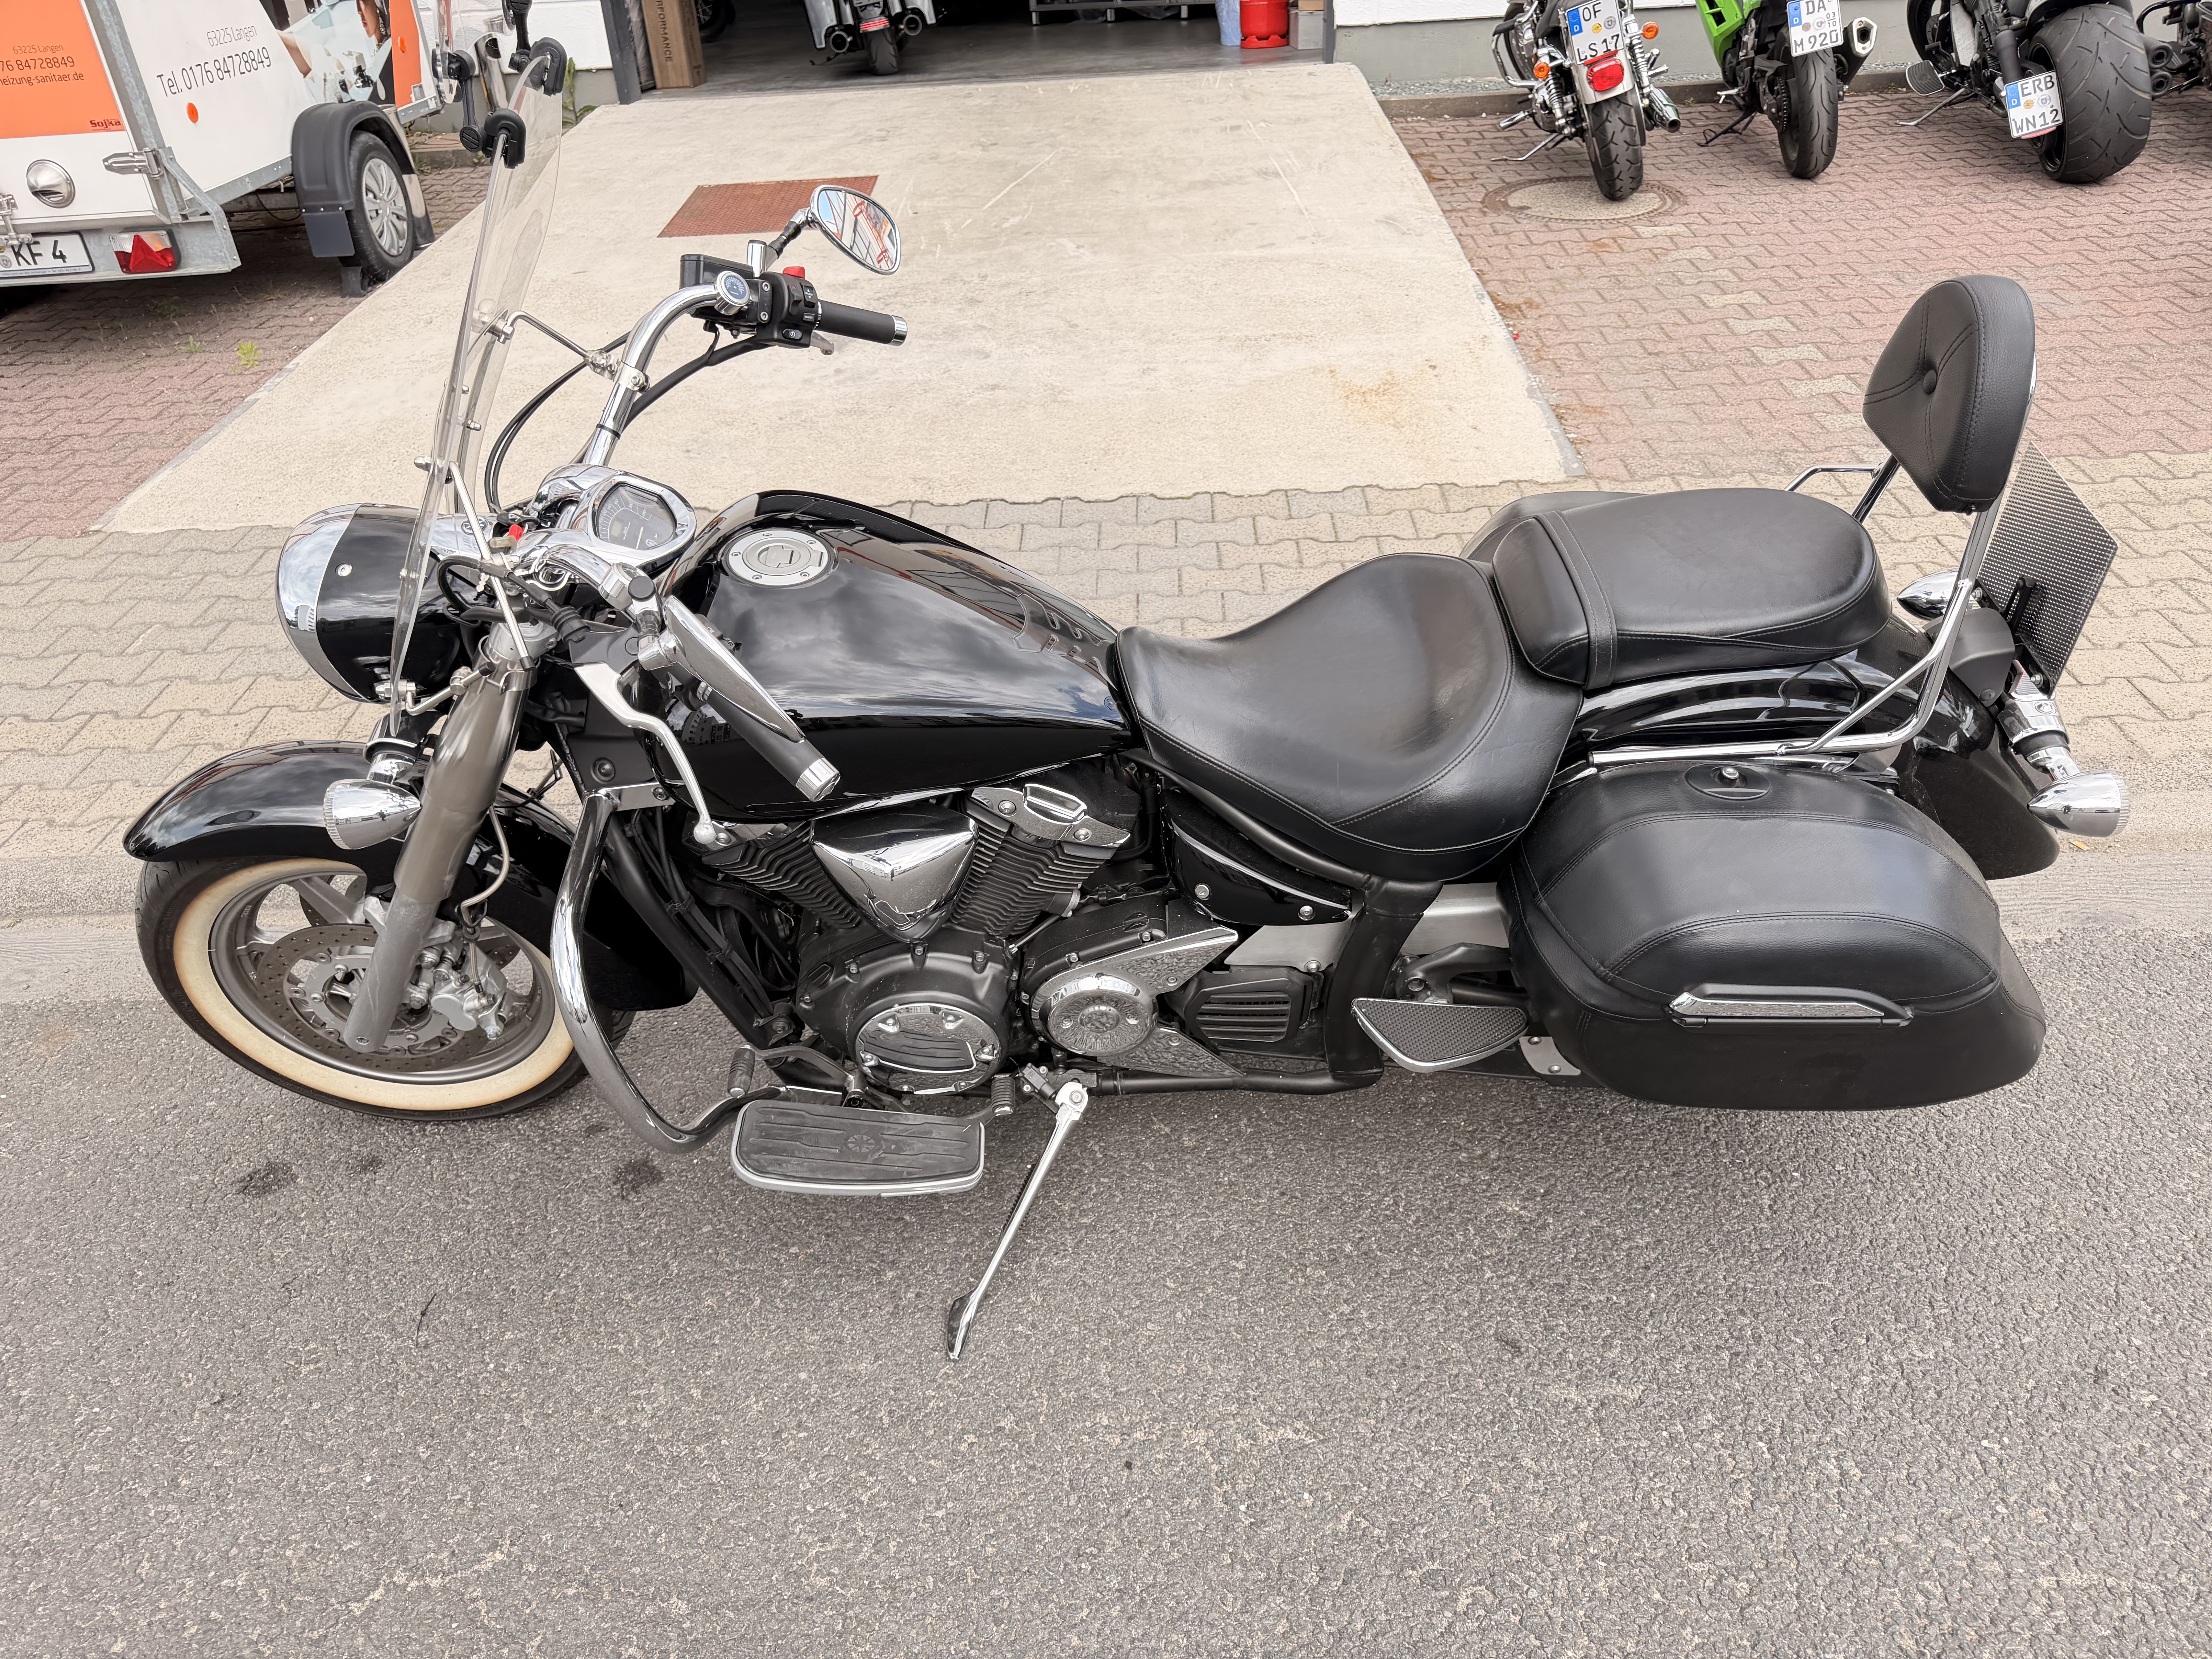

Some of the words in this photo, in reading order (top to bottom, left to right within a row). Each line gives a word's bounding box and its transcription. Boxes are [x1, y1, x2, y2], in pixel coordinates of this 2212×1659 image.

[1582, 2, 1601, 22] OF
[1805, 0, 1826, 15] DA
[206, 27, 232, 47] 63225
[230, 26, 257, 41] Langen
[1794, 38, 1804, 53] M
[1808, 29, 1839, 49] 920
[12, 45, 37, 54] 63225
[38, 45, 64, 53] Langen
[1577, 43, 1598, 62] LS
[1602, 34, 1620, 53] 17
[15, 56, 75, 70] 84728849
[156, 71, 183, 97] Tel.
[181, 62, 214, 90] 0176
[213, 47, 271, 81] 84728849
[2020, 75, 2055, 98] ERB
[89, 119, 121, 129] Sojka
[2013, 115, 2036, 134] WN
[2039, 109, 2060, 127] 12
[11, 241, 43, 266] KF
[52, 240, 67, 263] 4
